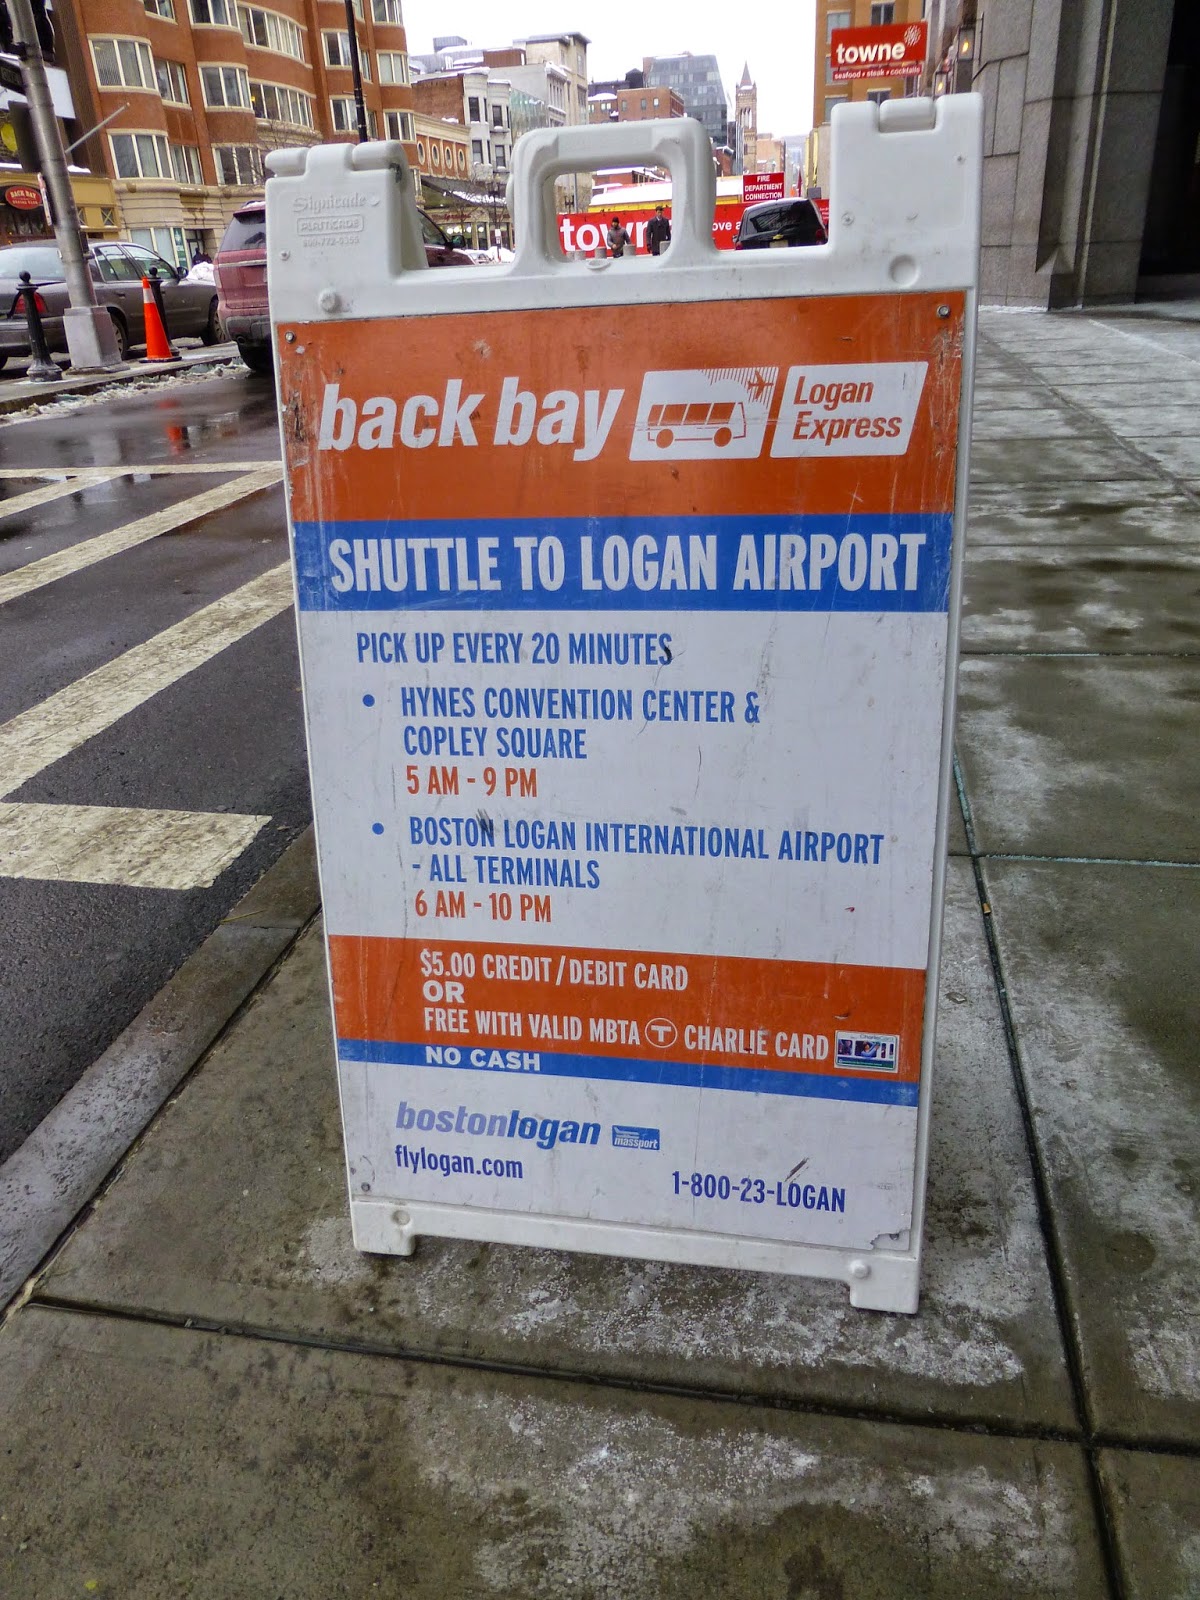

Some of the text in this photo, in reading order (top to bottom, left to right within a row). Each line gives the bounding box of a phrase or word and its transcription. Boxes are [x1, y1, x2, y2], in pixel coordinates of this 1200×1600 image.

[836, 42, 906, 64] towne
[834, 65, 921, 80] seafood steak cocktails
[744, 182, 783, 192] DEPARTMENT
[744, 191, 783, 201] CONNECTION
[756, 174, 771, 183] FIRE
[793, 376, 875, 410] Logan
[318, 376, 626, 462] back bay
[792, 411, 903, 446] Express
[328, 533, 927, 593] SHUTTLE TO LOGAN AIRPORT
[357, 632, 673, 666] PICK UP EVERY 20 MINUTES
[401, 687, 761, 724] HYNES CONVENTION CENTER &
[403, 725, 588, 760] COPLEY SQUARE
[406, 765, 420, 795] 5
[427, 766, 460, 796] AM
[483, 767, 497, 797] 9
[505, 768, 538, 798] PM
[410, 816, 885, 865] BOSTON LOGAN INTERNATIONAL AIRPORT
[430, 854, 468, 883] ALL
[474, 856, 601, 890] TERMINALS
[414, 889, 428, 917] 6
[435, 890, 466, 919] AM
[488, 892, 513, 921] 10
[519, 893, 552, 923] PM
[419, 949, 476, 978] $5.00
[634, 962, 689, 992] CARD
[422, 980, 466, 1004] OR
[424, 1007, 470, 1034] FREE
[475, 1010, 523, 1038] WITH
[528, 1014, 583, 1042] VALID
[589, 1018, 641, 1046] MBTA
[684, 1024, 768, 1056] CHARLIE
[775, 1032, 829, 1061] CARD
[425, 1046, 541, 1072] NO CASH
[395, 1101, 659, 1150] bostonlogan massport
[395, 1144, 524, 1179] flylogan.com
[671, 1170, 846, 1213] 1-800-23-LOGAN
